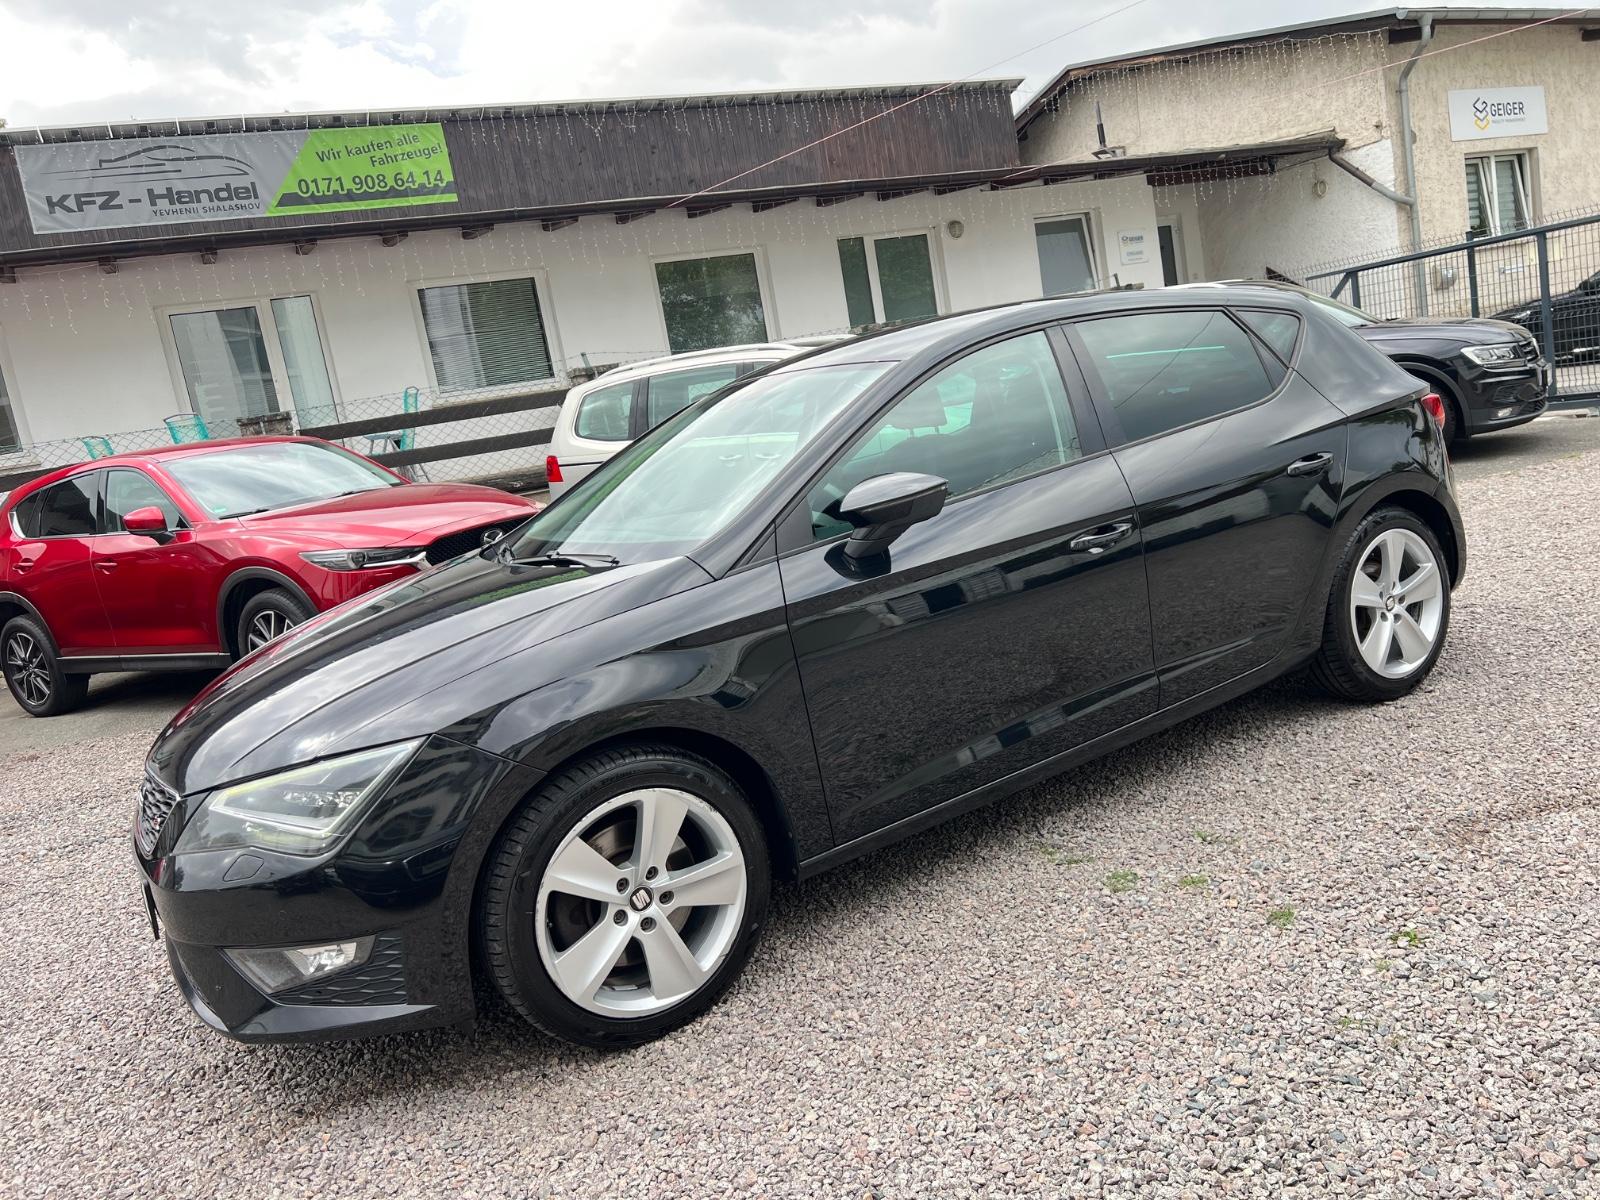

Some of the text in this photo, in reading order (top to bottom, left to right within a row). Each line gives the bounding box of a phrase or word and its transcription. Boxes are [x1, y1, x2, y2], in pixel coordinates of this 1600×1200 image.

[1490, 101, 1525, 117] GEIGER
[315, 133, 420, 163] Wir kaufen alle
[369, 142, 443, 168] Fahrzeuge!
[297, 169, 445, 196] 0171 908 64 14
[45, 190, 124, 215] KFZ
[146, 181, 260, 207] Handel
[152, 202, 262, 217] YEVHENII SHALASHOV
